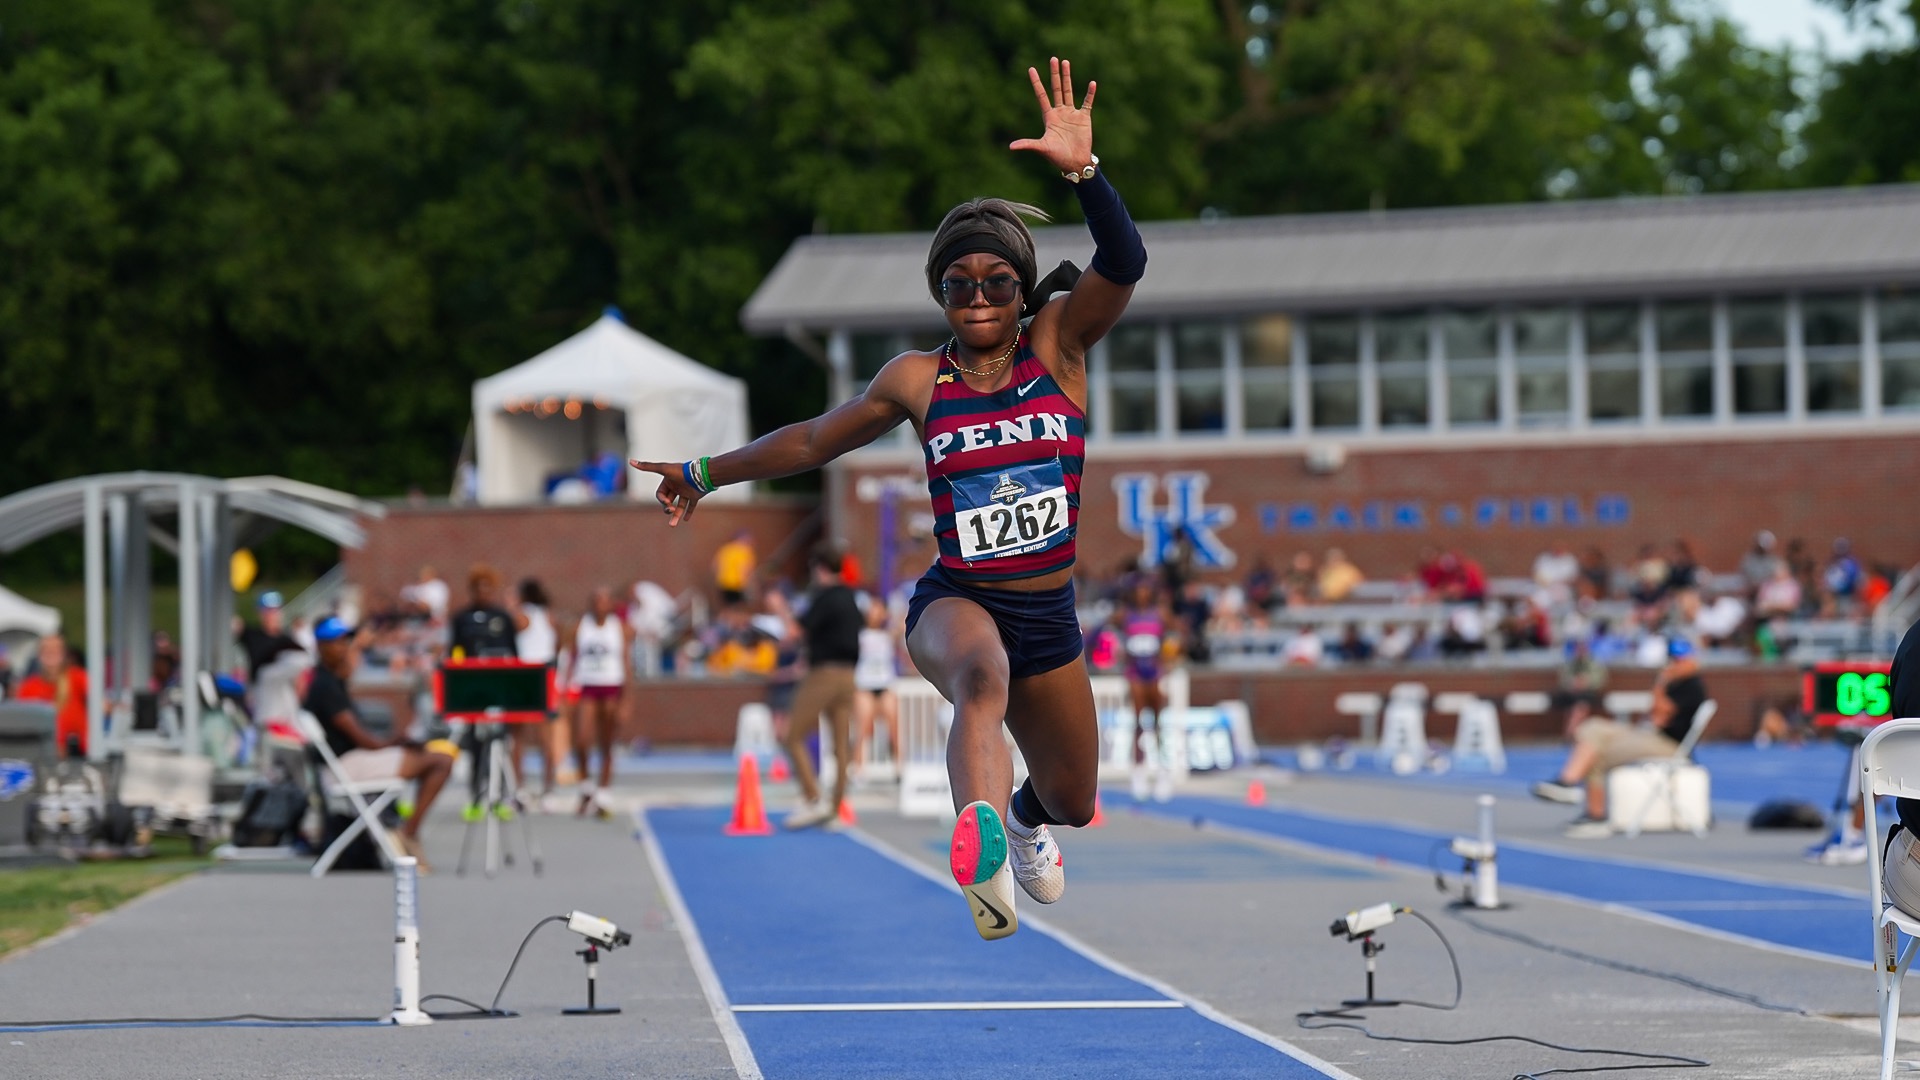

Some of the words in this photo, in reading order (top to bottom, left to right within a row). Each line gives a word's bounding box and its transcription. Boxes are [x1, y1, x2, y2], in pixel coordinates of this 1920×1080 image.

[929, 413, 1068, 465] PENN
[970, 496, 1061, 552] 1262
[1111, 472, 1237, 571] UK
[1258, 500, 1426, 534] TRACK
[1475, 494, 1631, 529] FIELD
